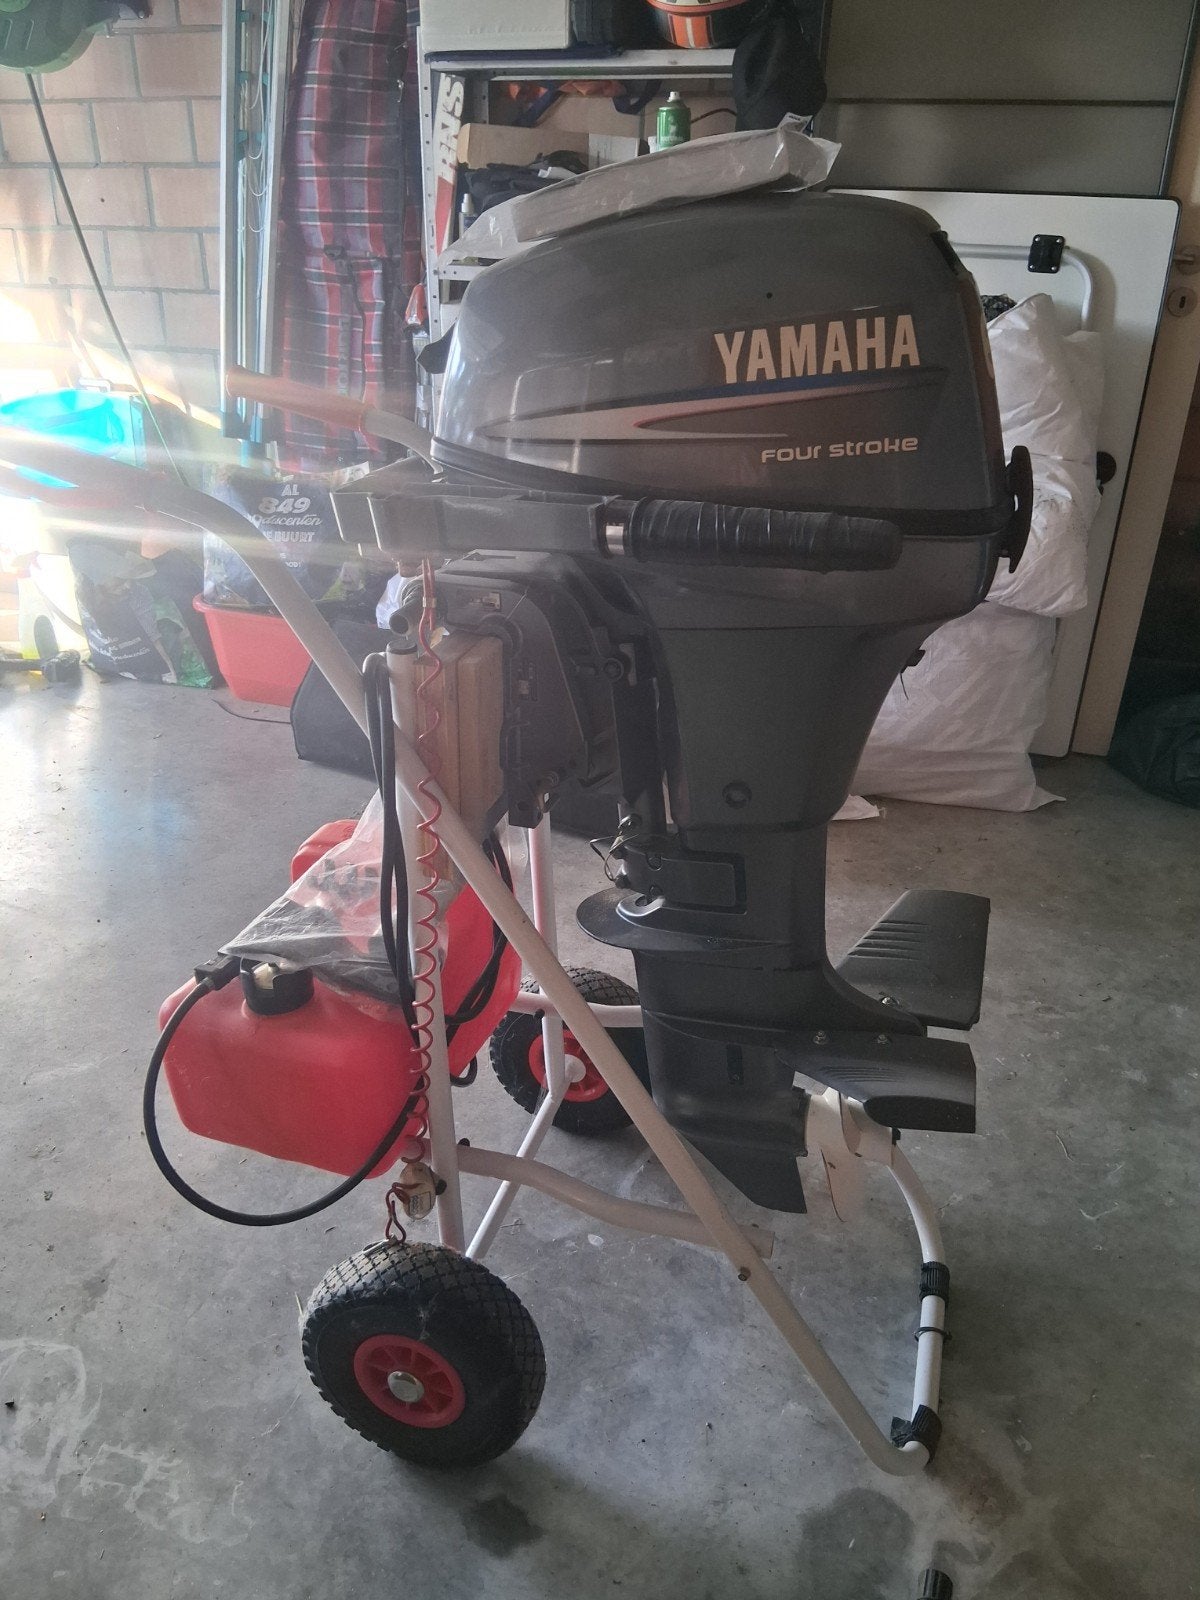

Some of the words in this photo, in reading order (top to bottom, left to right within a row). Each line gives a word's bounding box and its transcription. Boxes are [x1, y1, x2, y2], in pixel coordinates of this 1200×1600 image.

[714, 314, 920, 384] YAMAHA
[281, 484, 300, 496] AL
[258, 497, 311, 514] 849
[274, 531, 316, 543] BUURT
